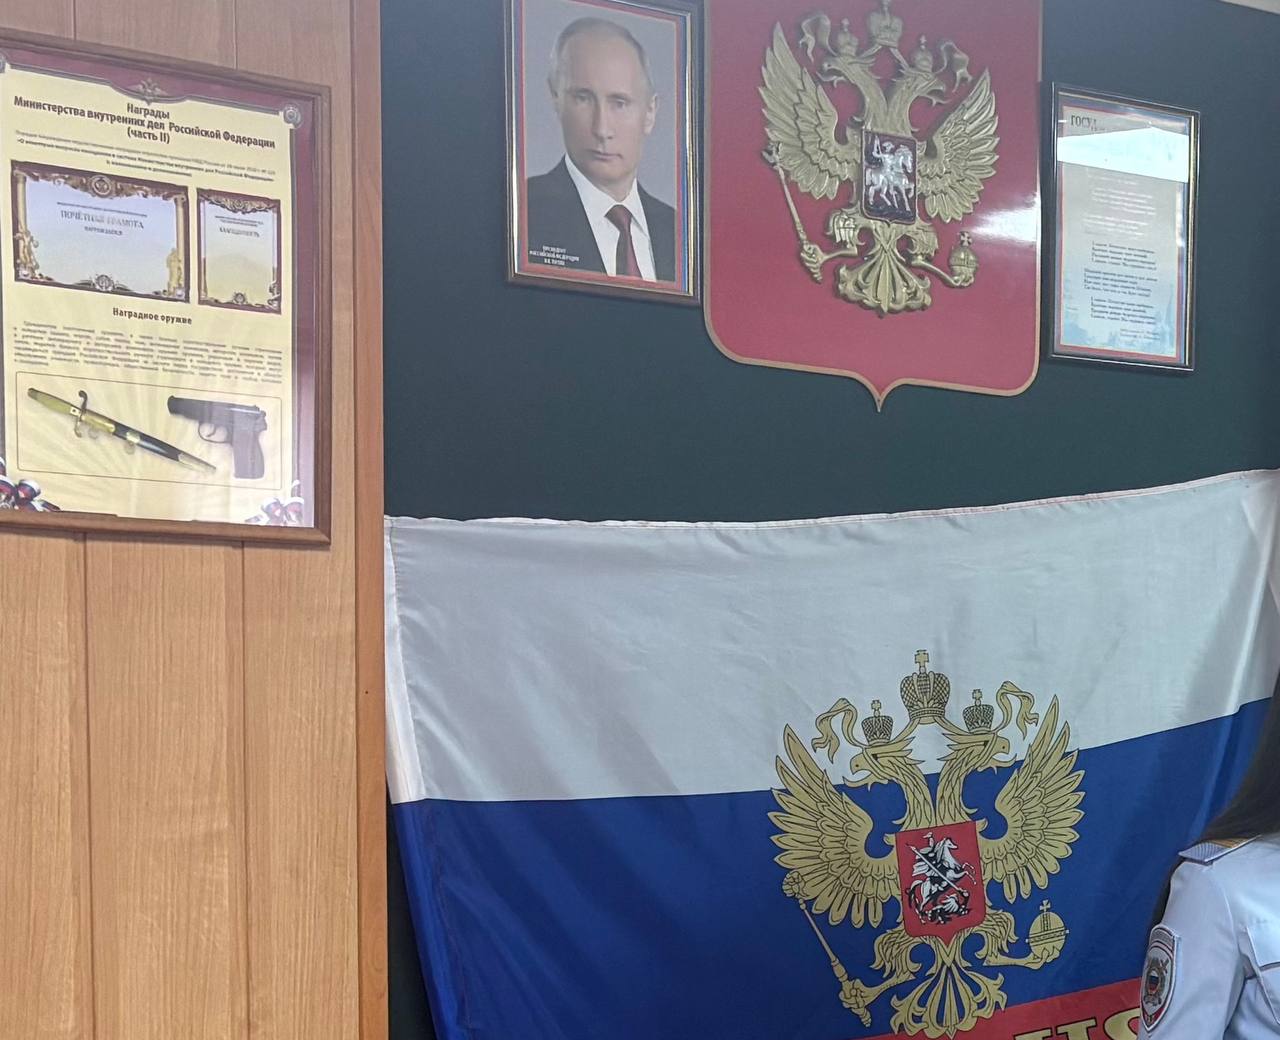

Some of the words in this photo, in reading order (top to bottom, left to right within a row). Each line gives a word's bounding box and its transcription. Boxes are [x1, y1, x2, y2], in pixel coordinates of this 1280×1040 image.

[127, 103, 170, 119] Награды
[14, 96, 86, 116] Министерства
[87, 109, 146, 127] внутренних
[147, 120, 165, 130] дел
[169, 121, 222, 140] Российской
[223, 131, 276, 149] Федерации
[127, 127, 158, 141] (часть
[112, 307, 159, 320] Наградное
[160, 314, 192, 325] оружие
